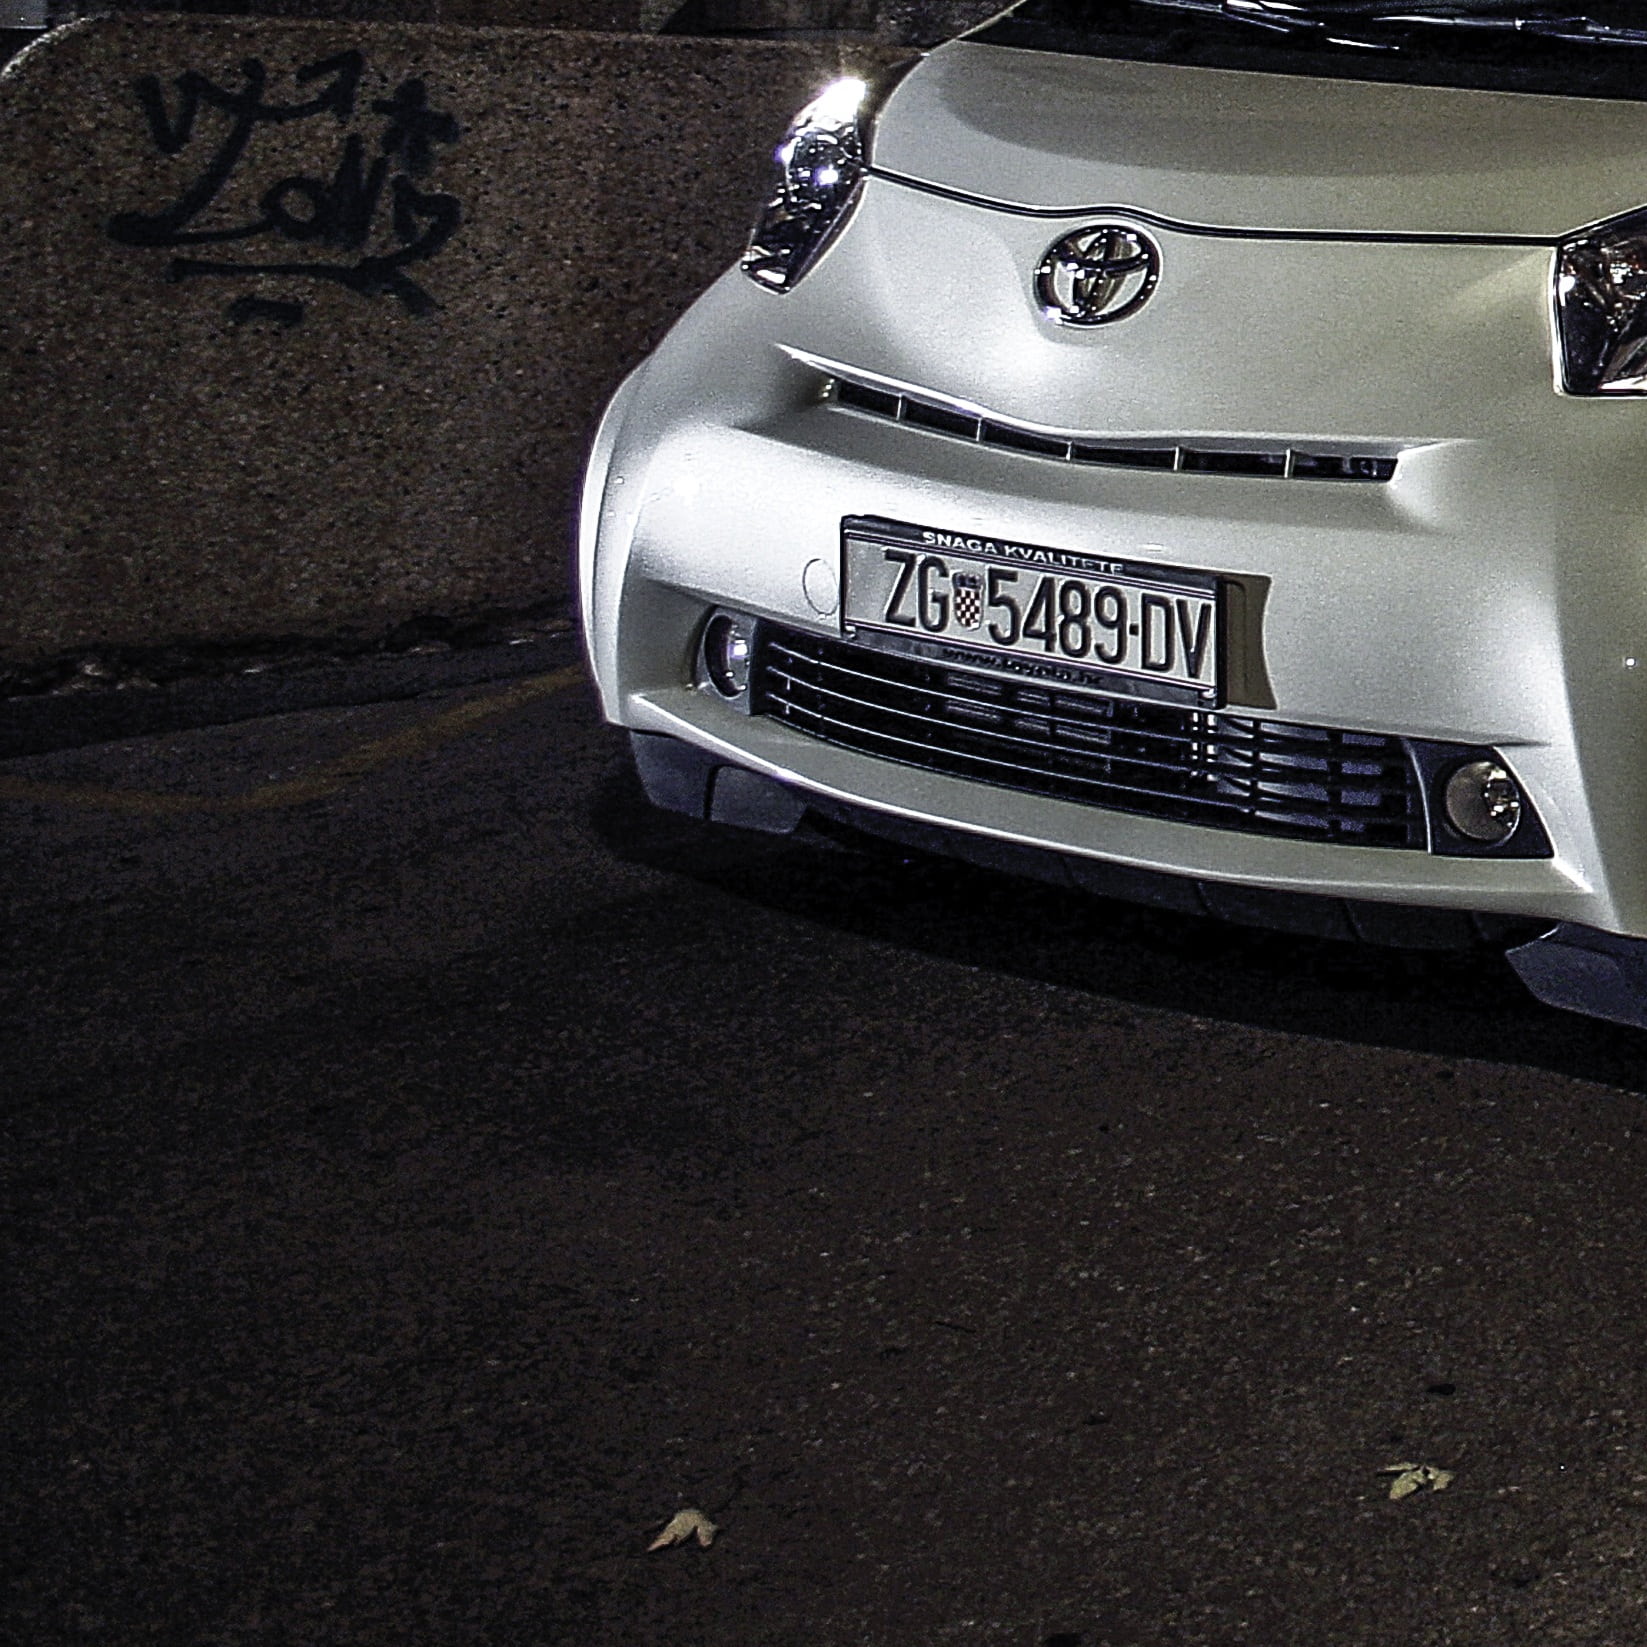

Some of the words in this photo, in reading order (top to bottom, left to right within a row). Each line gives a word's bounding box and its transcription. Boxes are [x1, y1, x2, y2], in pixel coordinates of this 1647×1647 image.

[922, 531, 997, 554] SNAGA
[1004, 545, 1124, 576] KVALITETE
[884, 547, 950, 632] ZG
